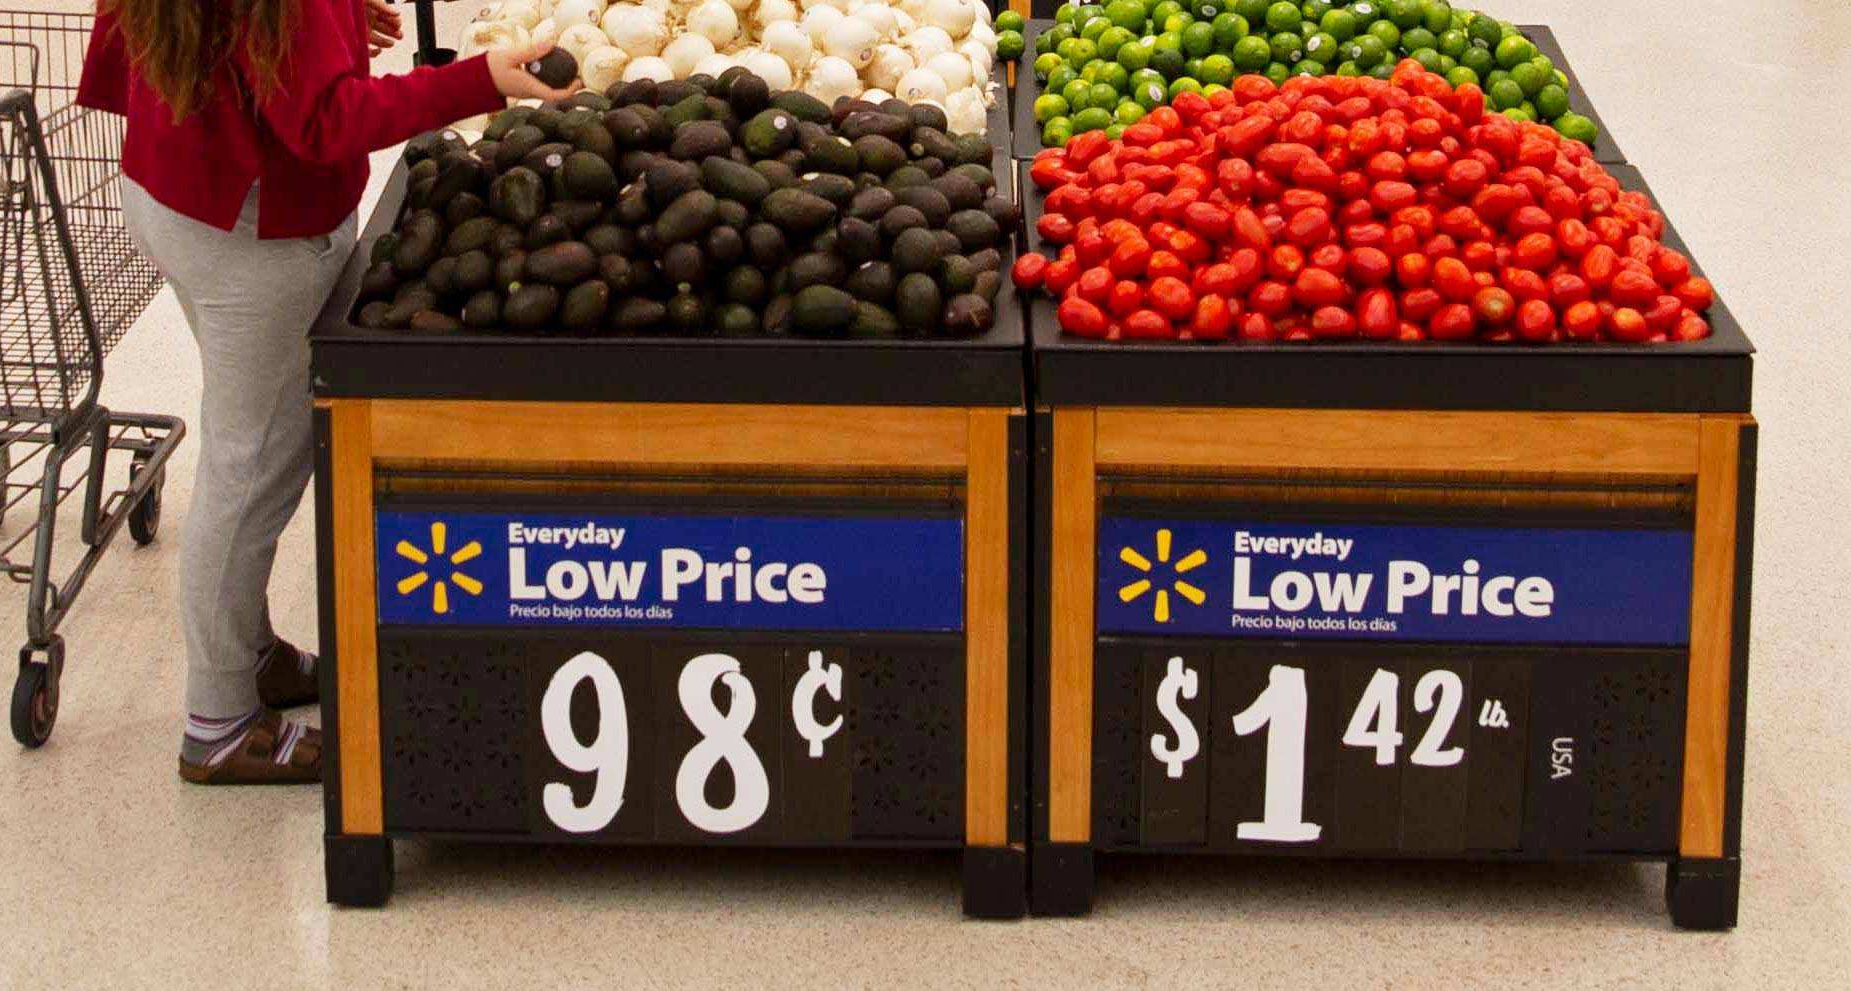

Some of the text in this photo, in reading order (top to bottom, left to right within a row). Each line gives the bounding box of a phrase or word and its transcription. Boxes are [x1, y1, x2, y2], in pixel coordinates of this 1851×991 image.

[508, 522, 626, 549] Everyday
[1234, 531, 1353, 559] Everyday
[508, 546, 827, 604] Low Price
[1232, 556, 1555, 617] Low Price
[510, 604, 550, 618] Precio
[552, 604, 582, 620] bajo
[585, 605, 622, 619] todos
[625, 605, 643, 619] los
[1232, 614, 1273, 628] Precio
[1276, 614, 1305, 632] bajo
[1307, 616, 1346, 630] todos
[1348, 617, 1367, 631] los
[1478, 699, 1510, 729] lb.
[540, 650, 843, 833] 98¢
[1551, 737, 1573, 779] USA
